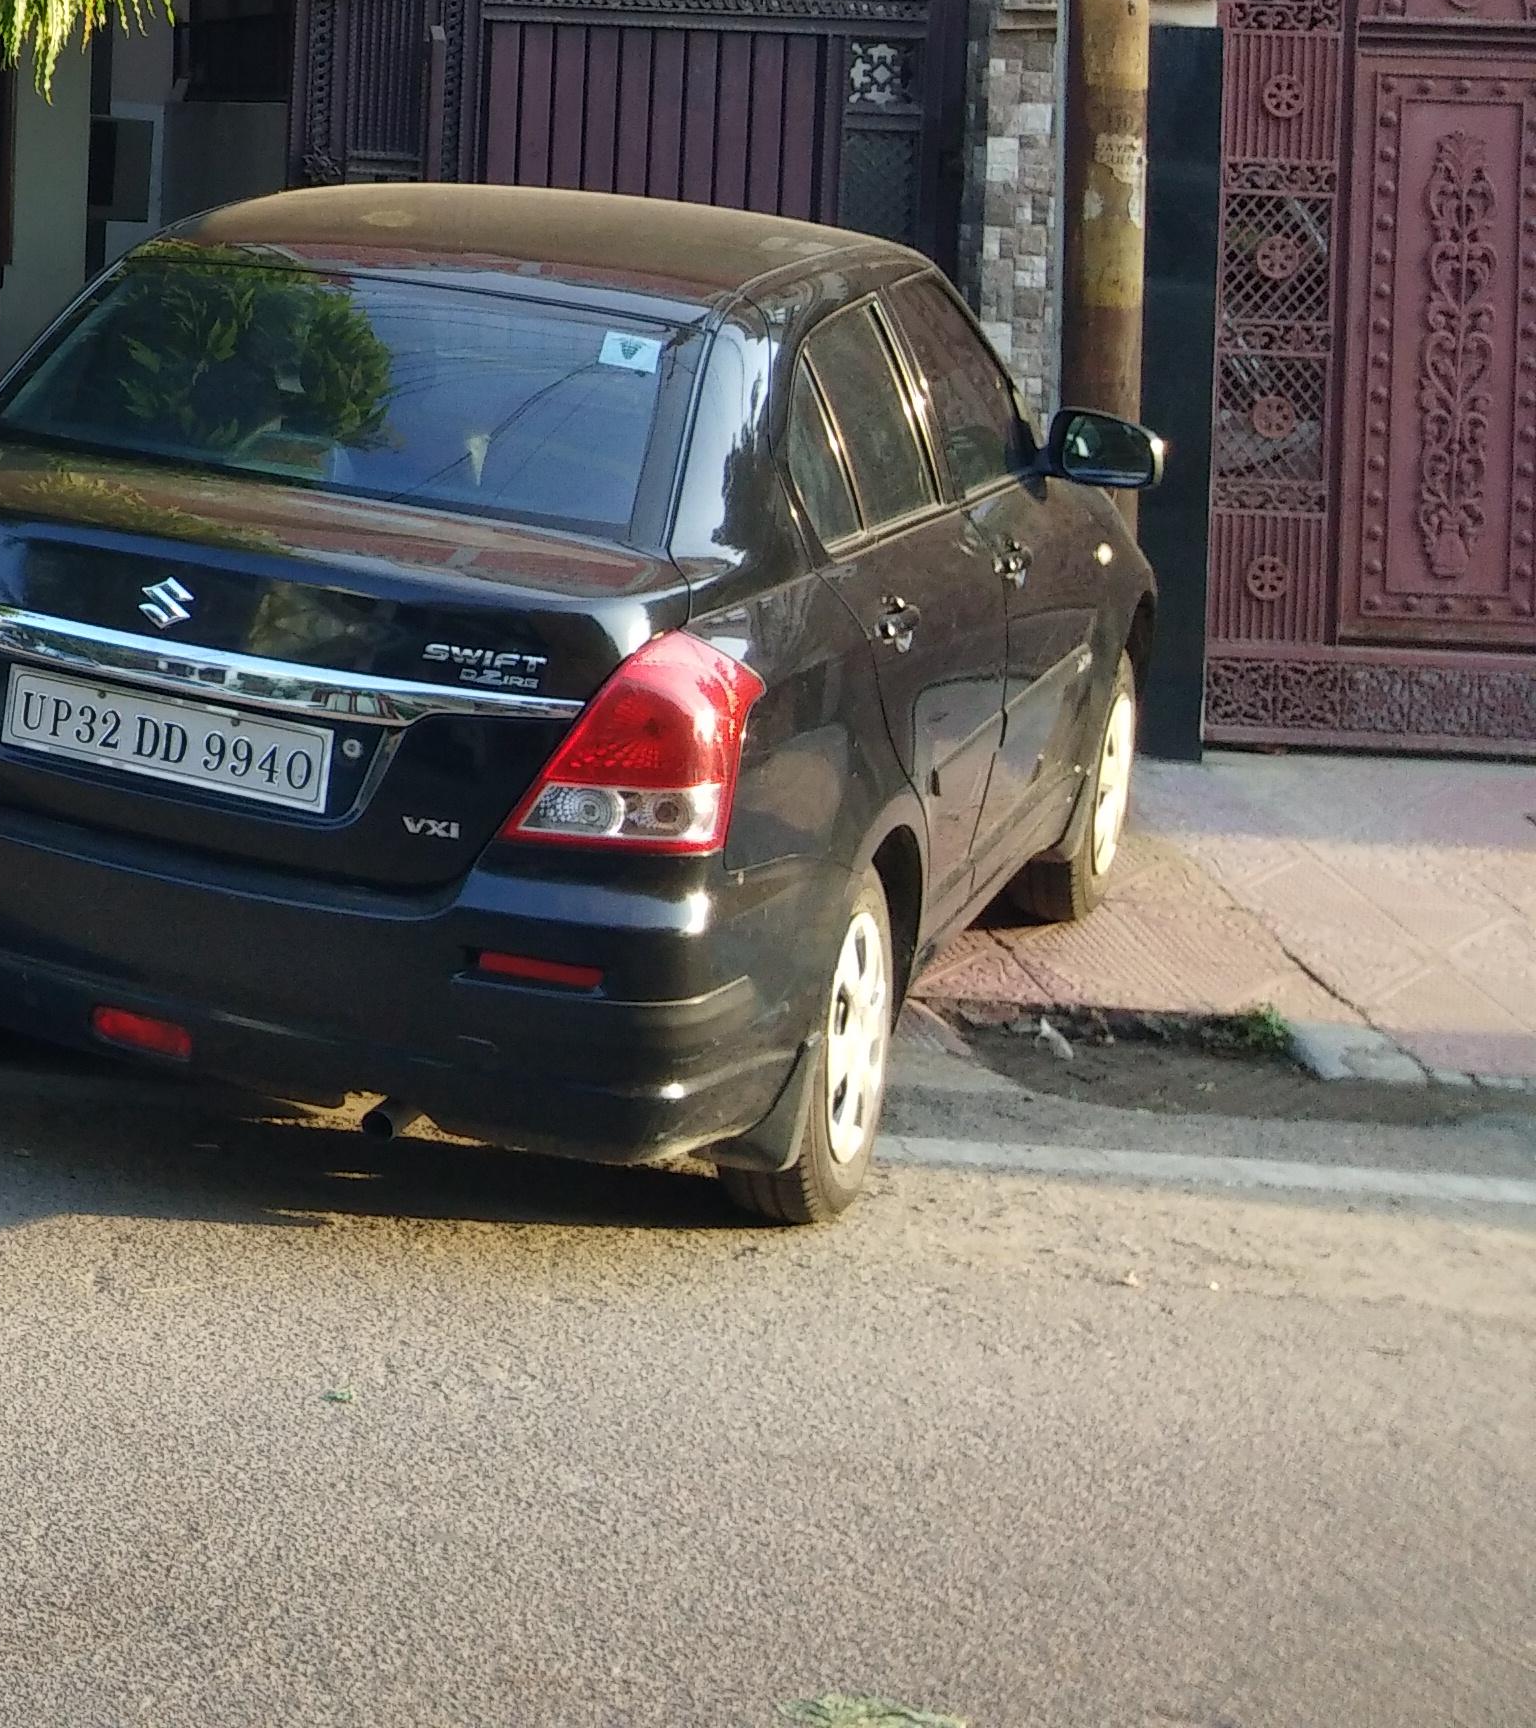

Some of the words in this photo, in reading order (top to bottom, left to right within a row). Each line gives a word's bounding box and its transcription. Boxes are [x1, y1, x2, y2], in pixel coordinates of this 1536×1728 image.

[422, 643, 548, 672] SWIFT
[22, 690, 122, 750] UP32
[133, 715, 188, 764] DD
[201, 731, 313, 791] 9940
